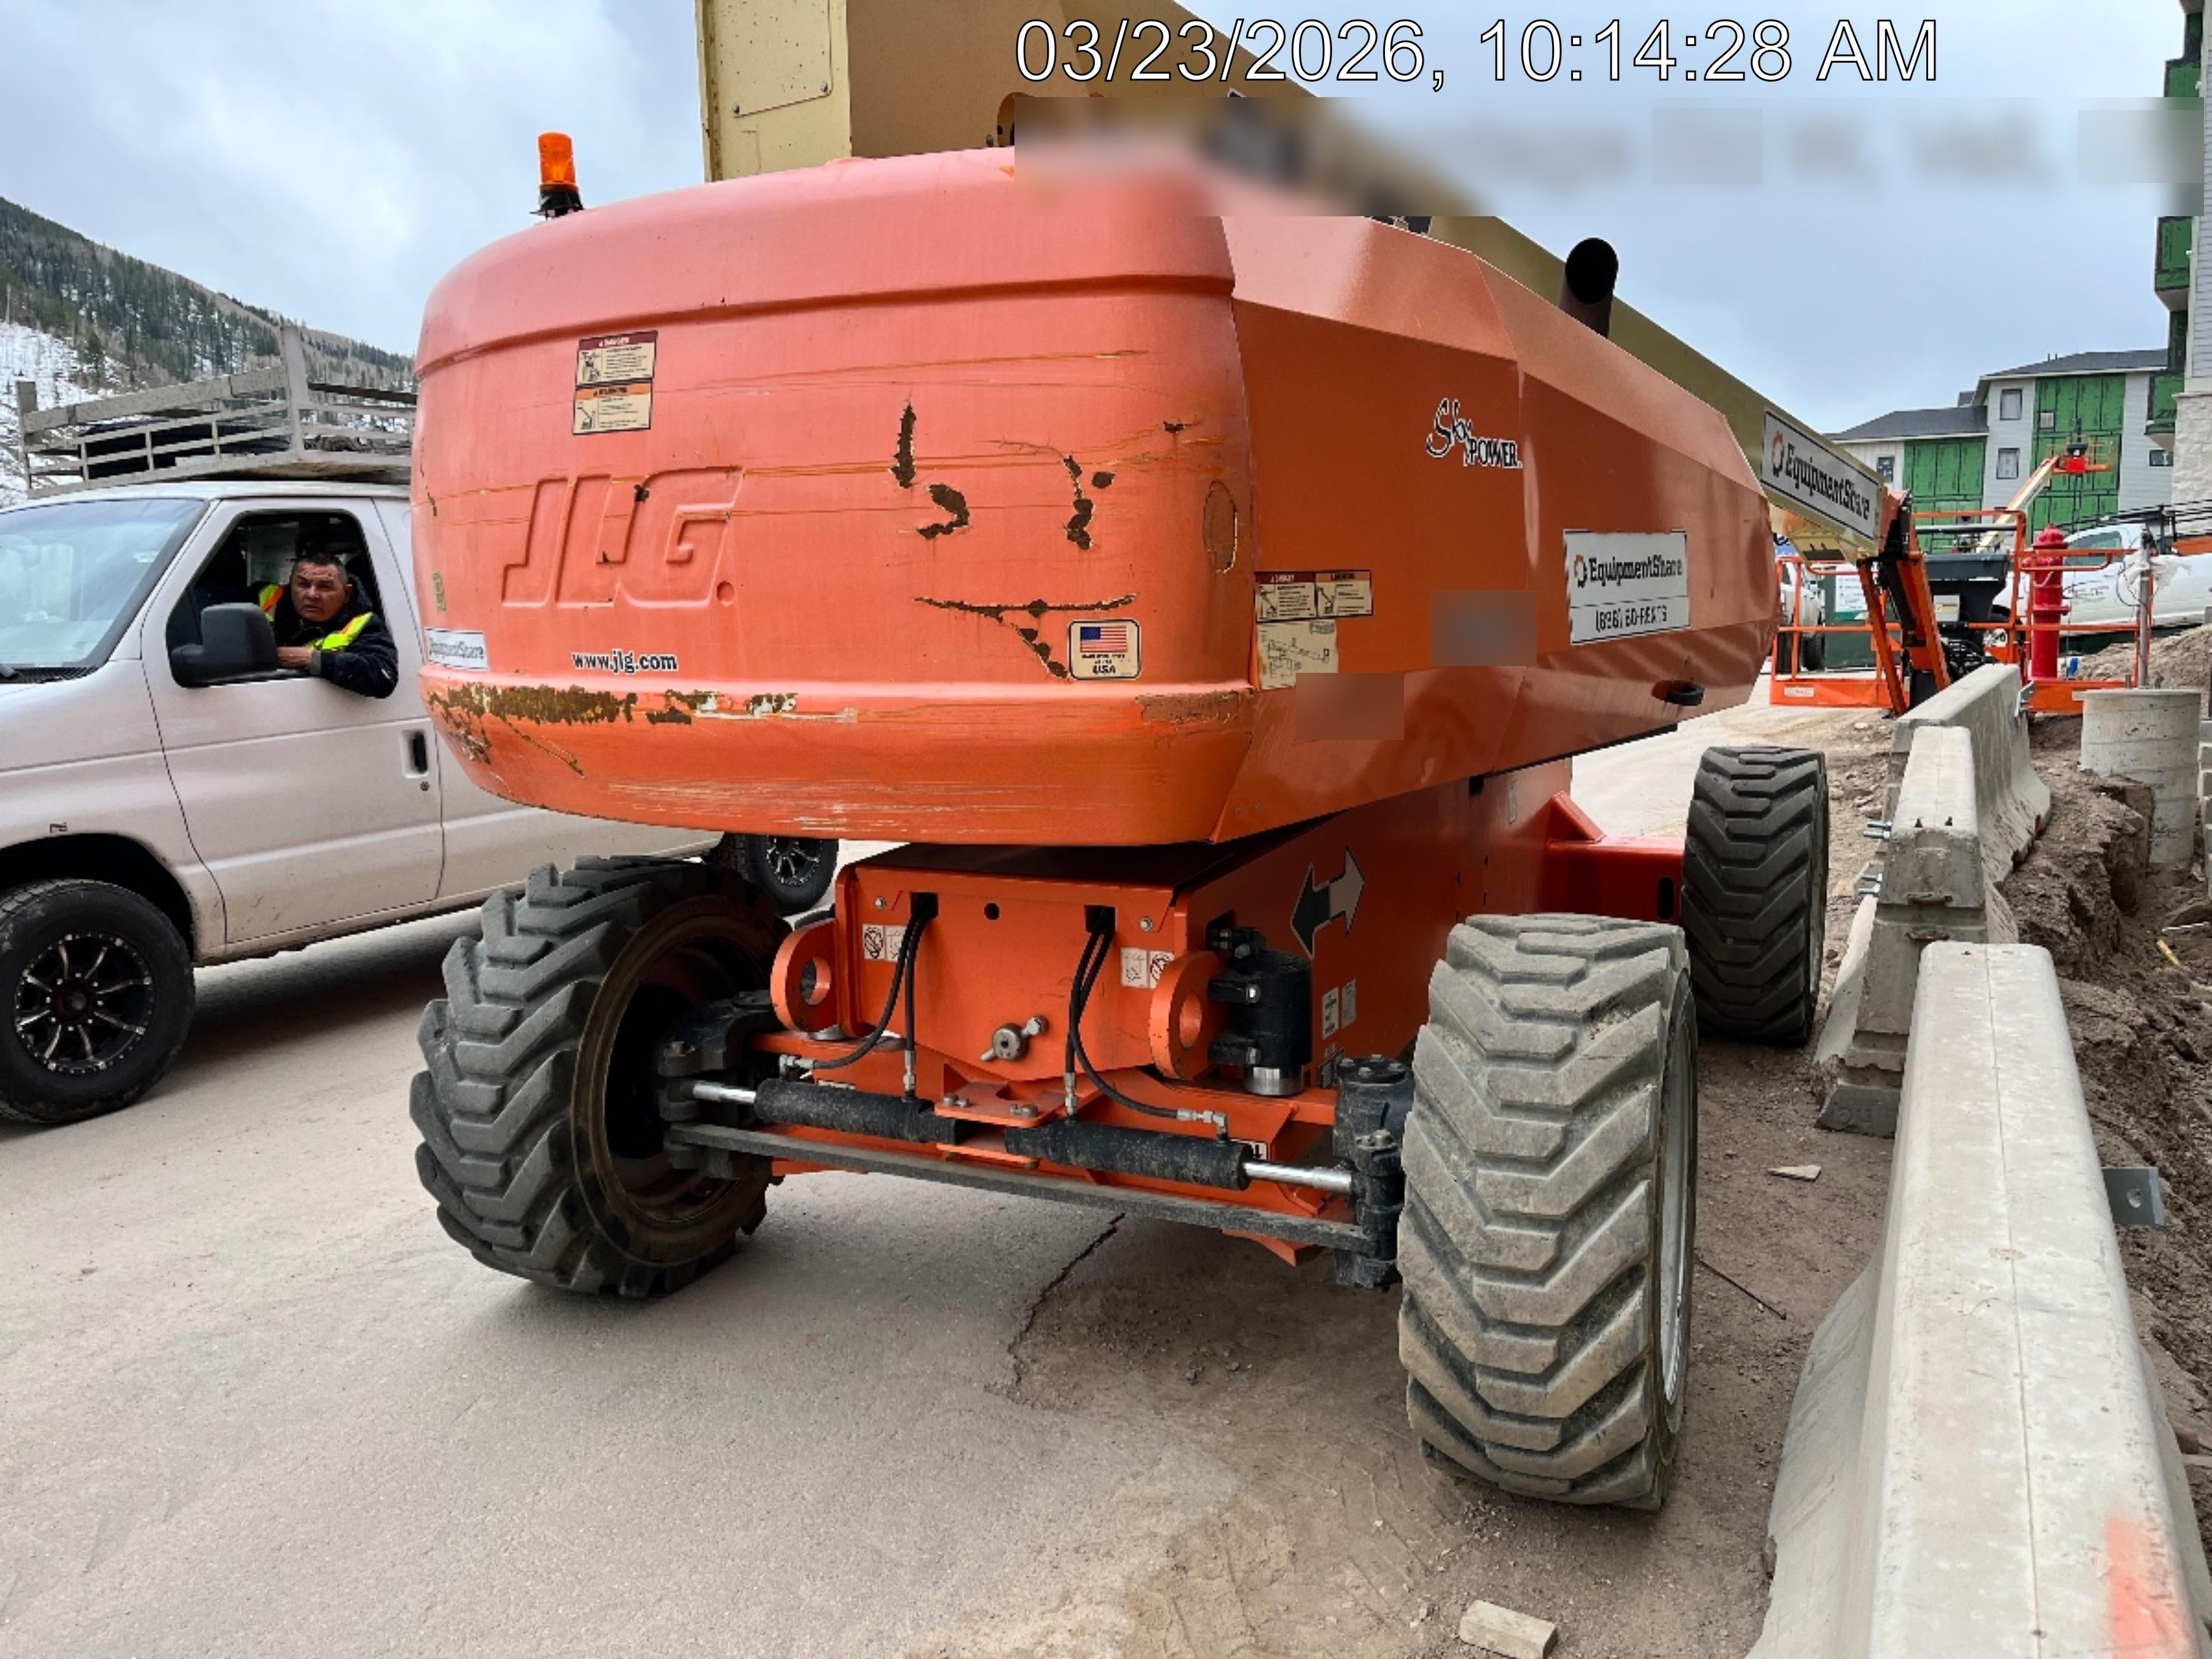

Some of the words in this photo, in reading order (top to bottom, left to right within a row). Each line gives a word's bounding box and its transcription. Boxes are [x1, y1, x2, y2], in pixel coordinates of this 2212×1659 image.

[1467, 437, 1521, 469] POWER
[1785, 442, 1870, 520] EquipmentShare
[502, 466, 745, 608] JLG
[1588, 554, 1682, 587] EquipmentShare
[571, 649, 678, 673] www.jlg.com
[1092, 665, 1116, 675] USA
